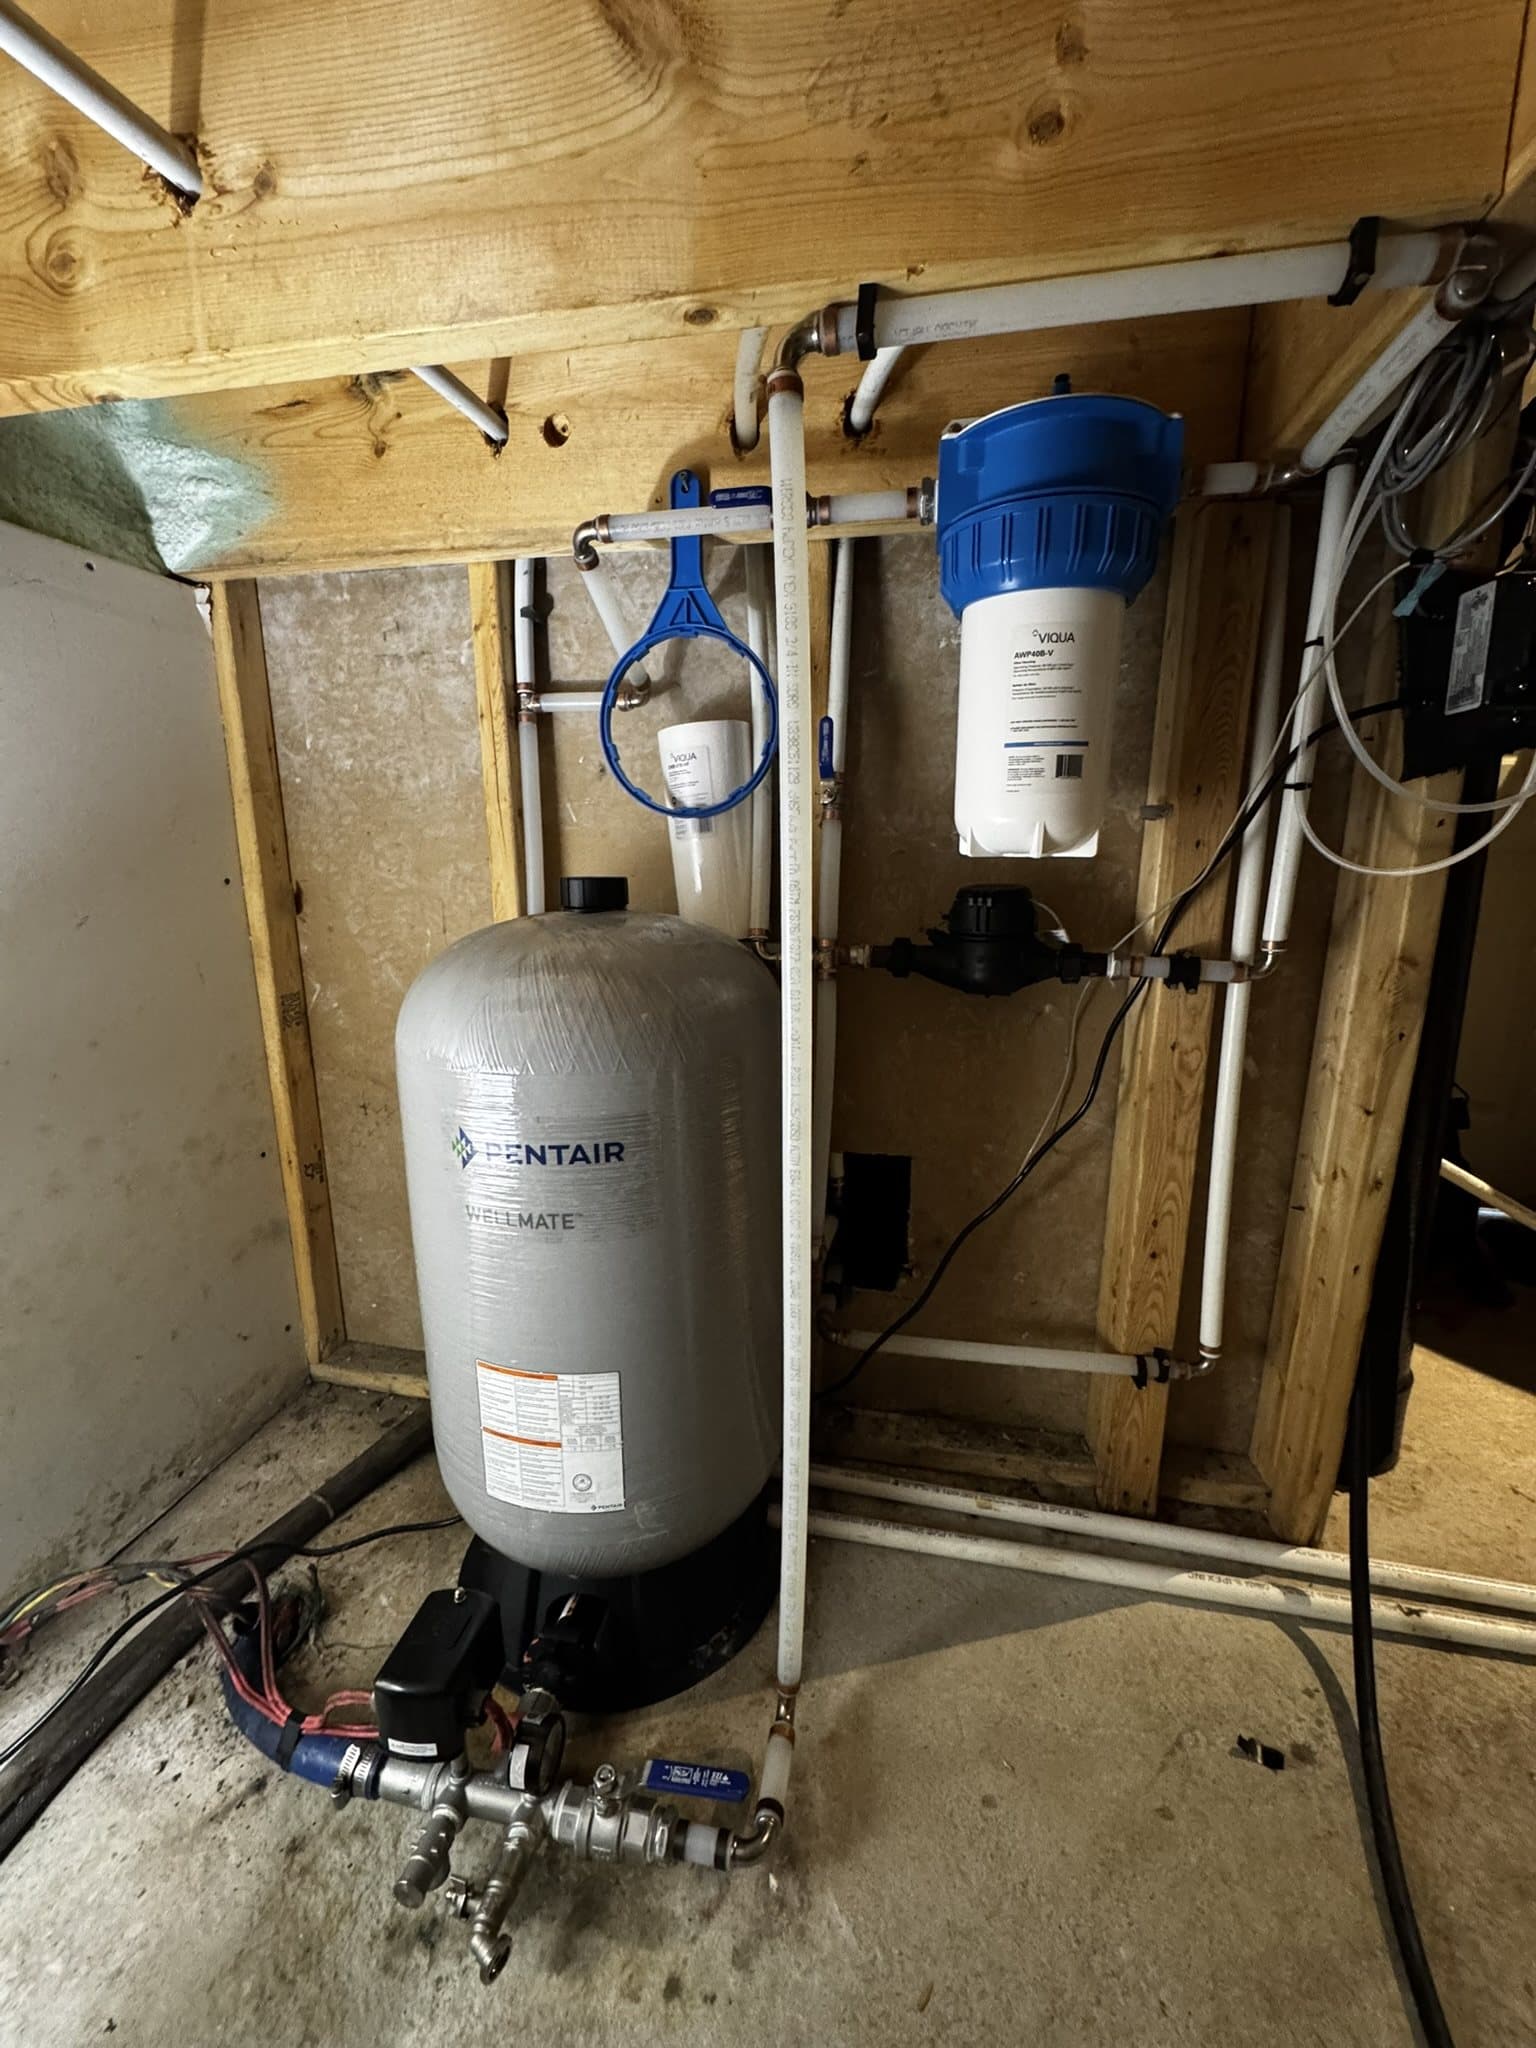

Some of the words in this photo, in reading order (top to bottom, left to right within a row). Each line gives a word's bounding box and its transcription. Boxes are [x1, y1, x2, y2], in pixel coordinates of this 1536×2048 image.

[1038, 632, 1075, 643] VIQUA
[1014, 649, 1054, 659] AWP40B-V
[485, 1141, 625, 1166] PENTAIR
[466, 1204, 575, 1230] WELLMATE
